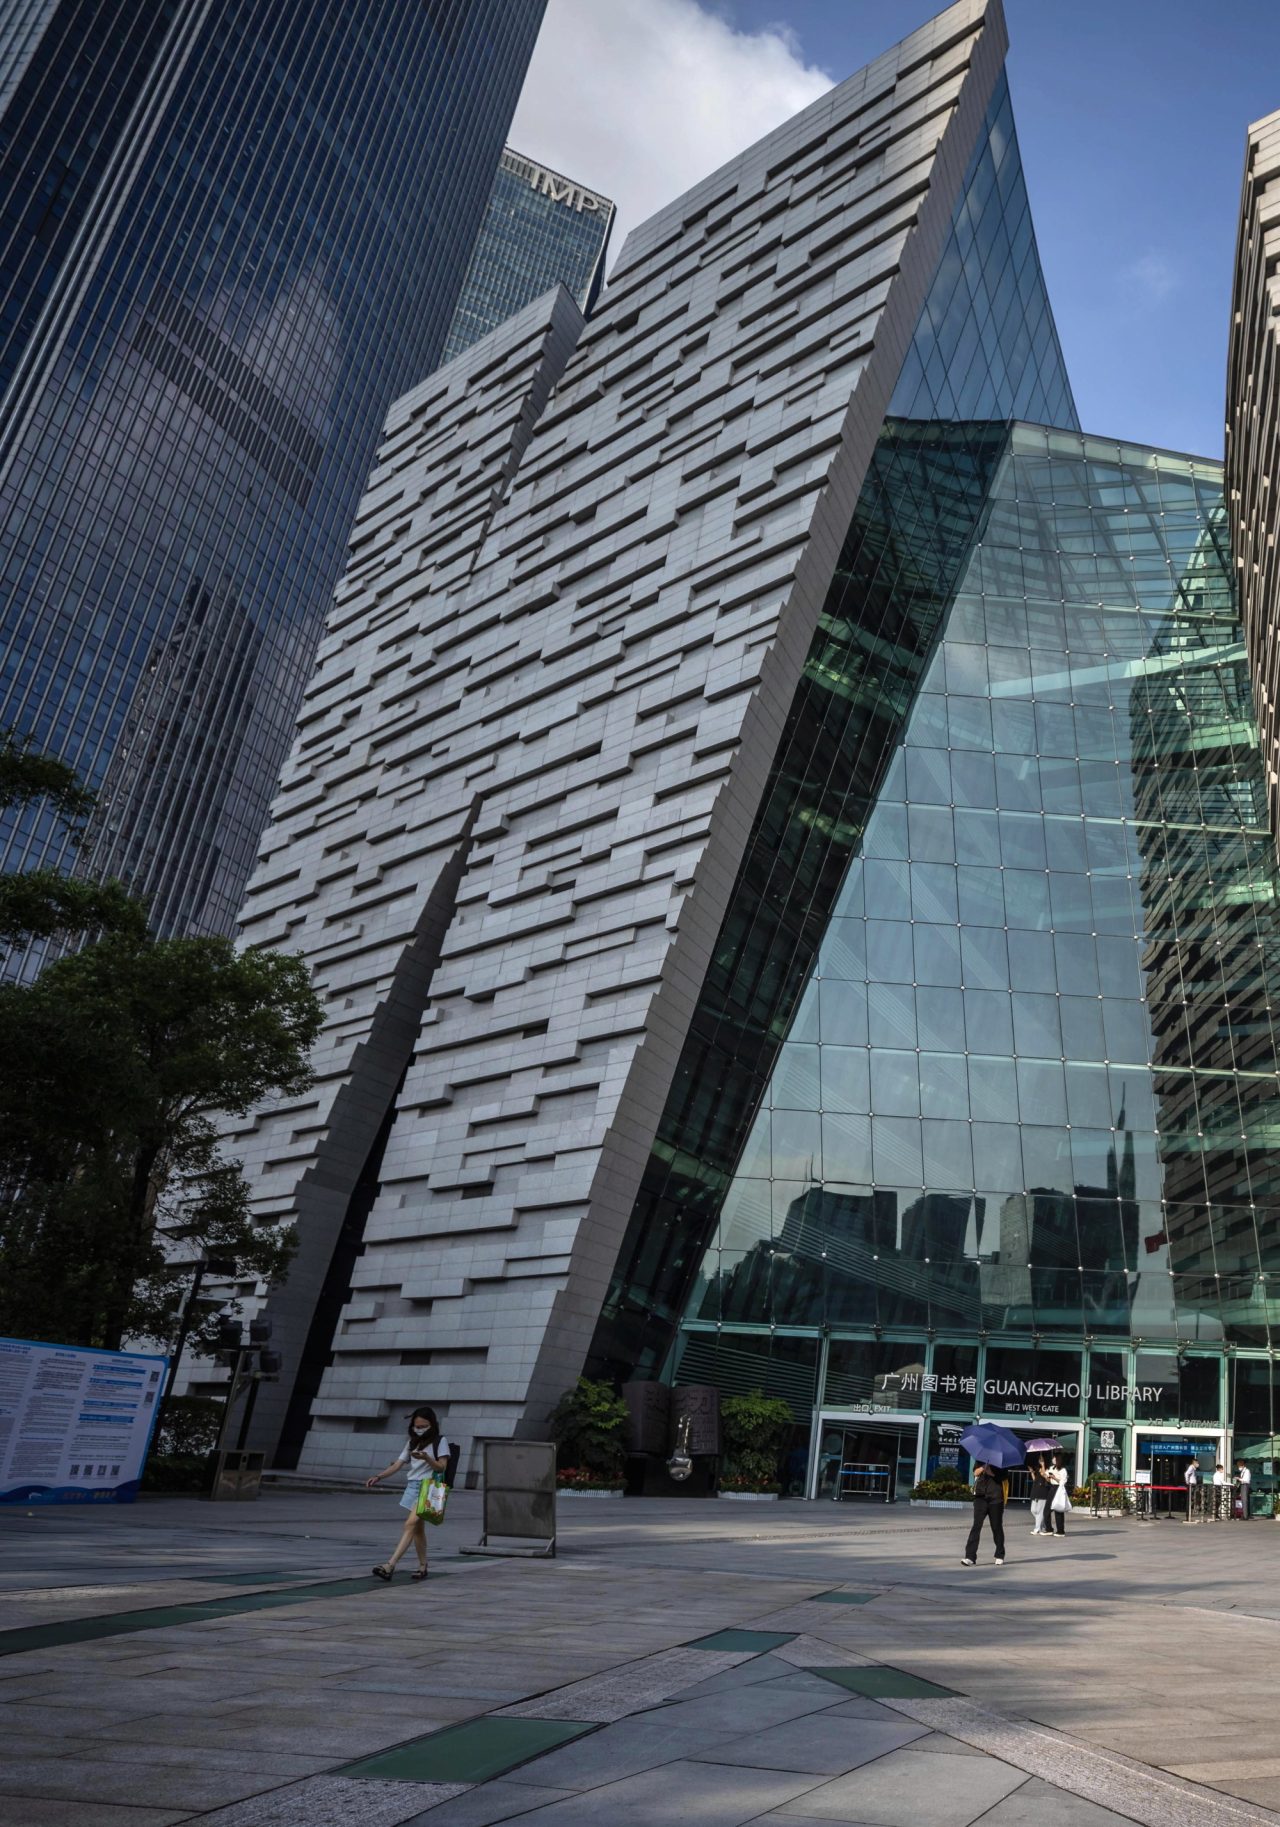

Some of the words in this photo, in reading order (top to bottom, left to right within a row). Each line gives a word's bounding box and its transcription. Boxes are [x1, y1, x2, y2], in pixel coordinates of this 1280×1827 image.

[530, 168, 600, 213] IMP
[881, 1373, 977, 1394] 广州图书馆
[984, 1379, 1092, 1399] GUANGZHOU
[1096, 1383, 1163, 1402] LIBRARY
[853, 1403, 869, 1413] 出口
[874, 1404, 891, 1413] EXIT
[1005, 1402, 1020, 1412] 西门
[1021, 1403, 1041, 1412] WEST
[1042, 1404, 1060, 1413] GATE
